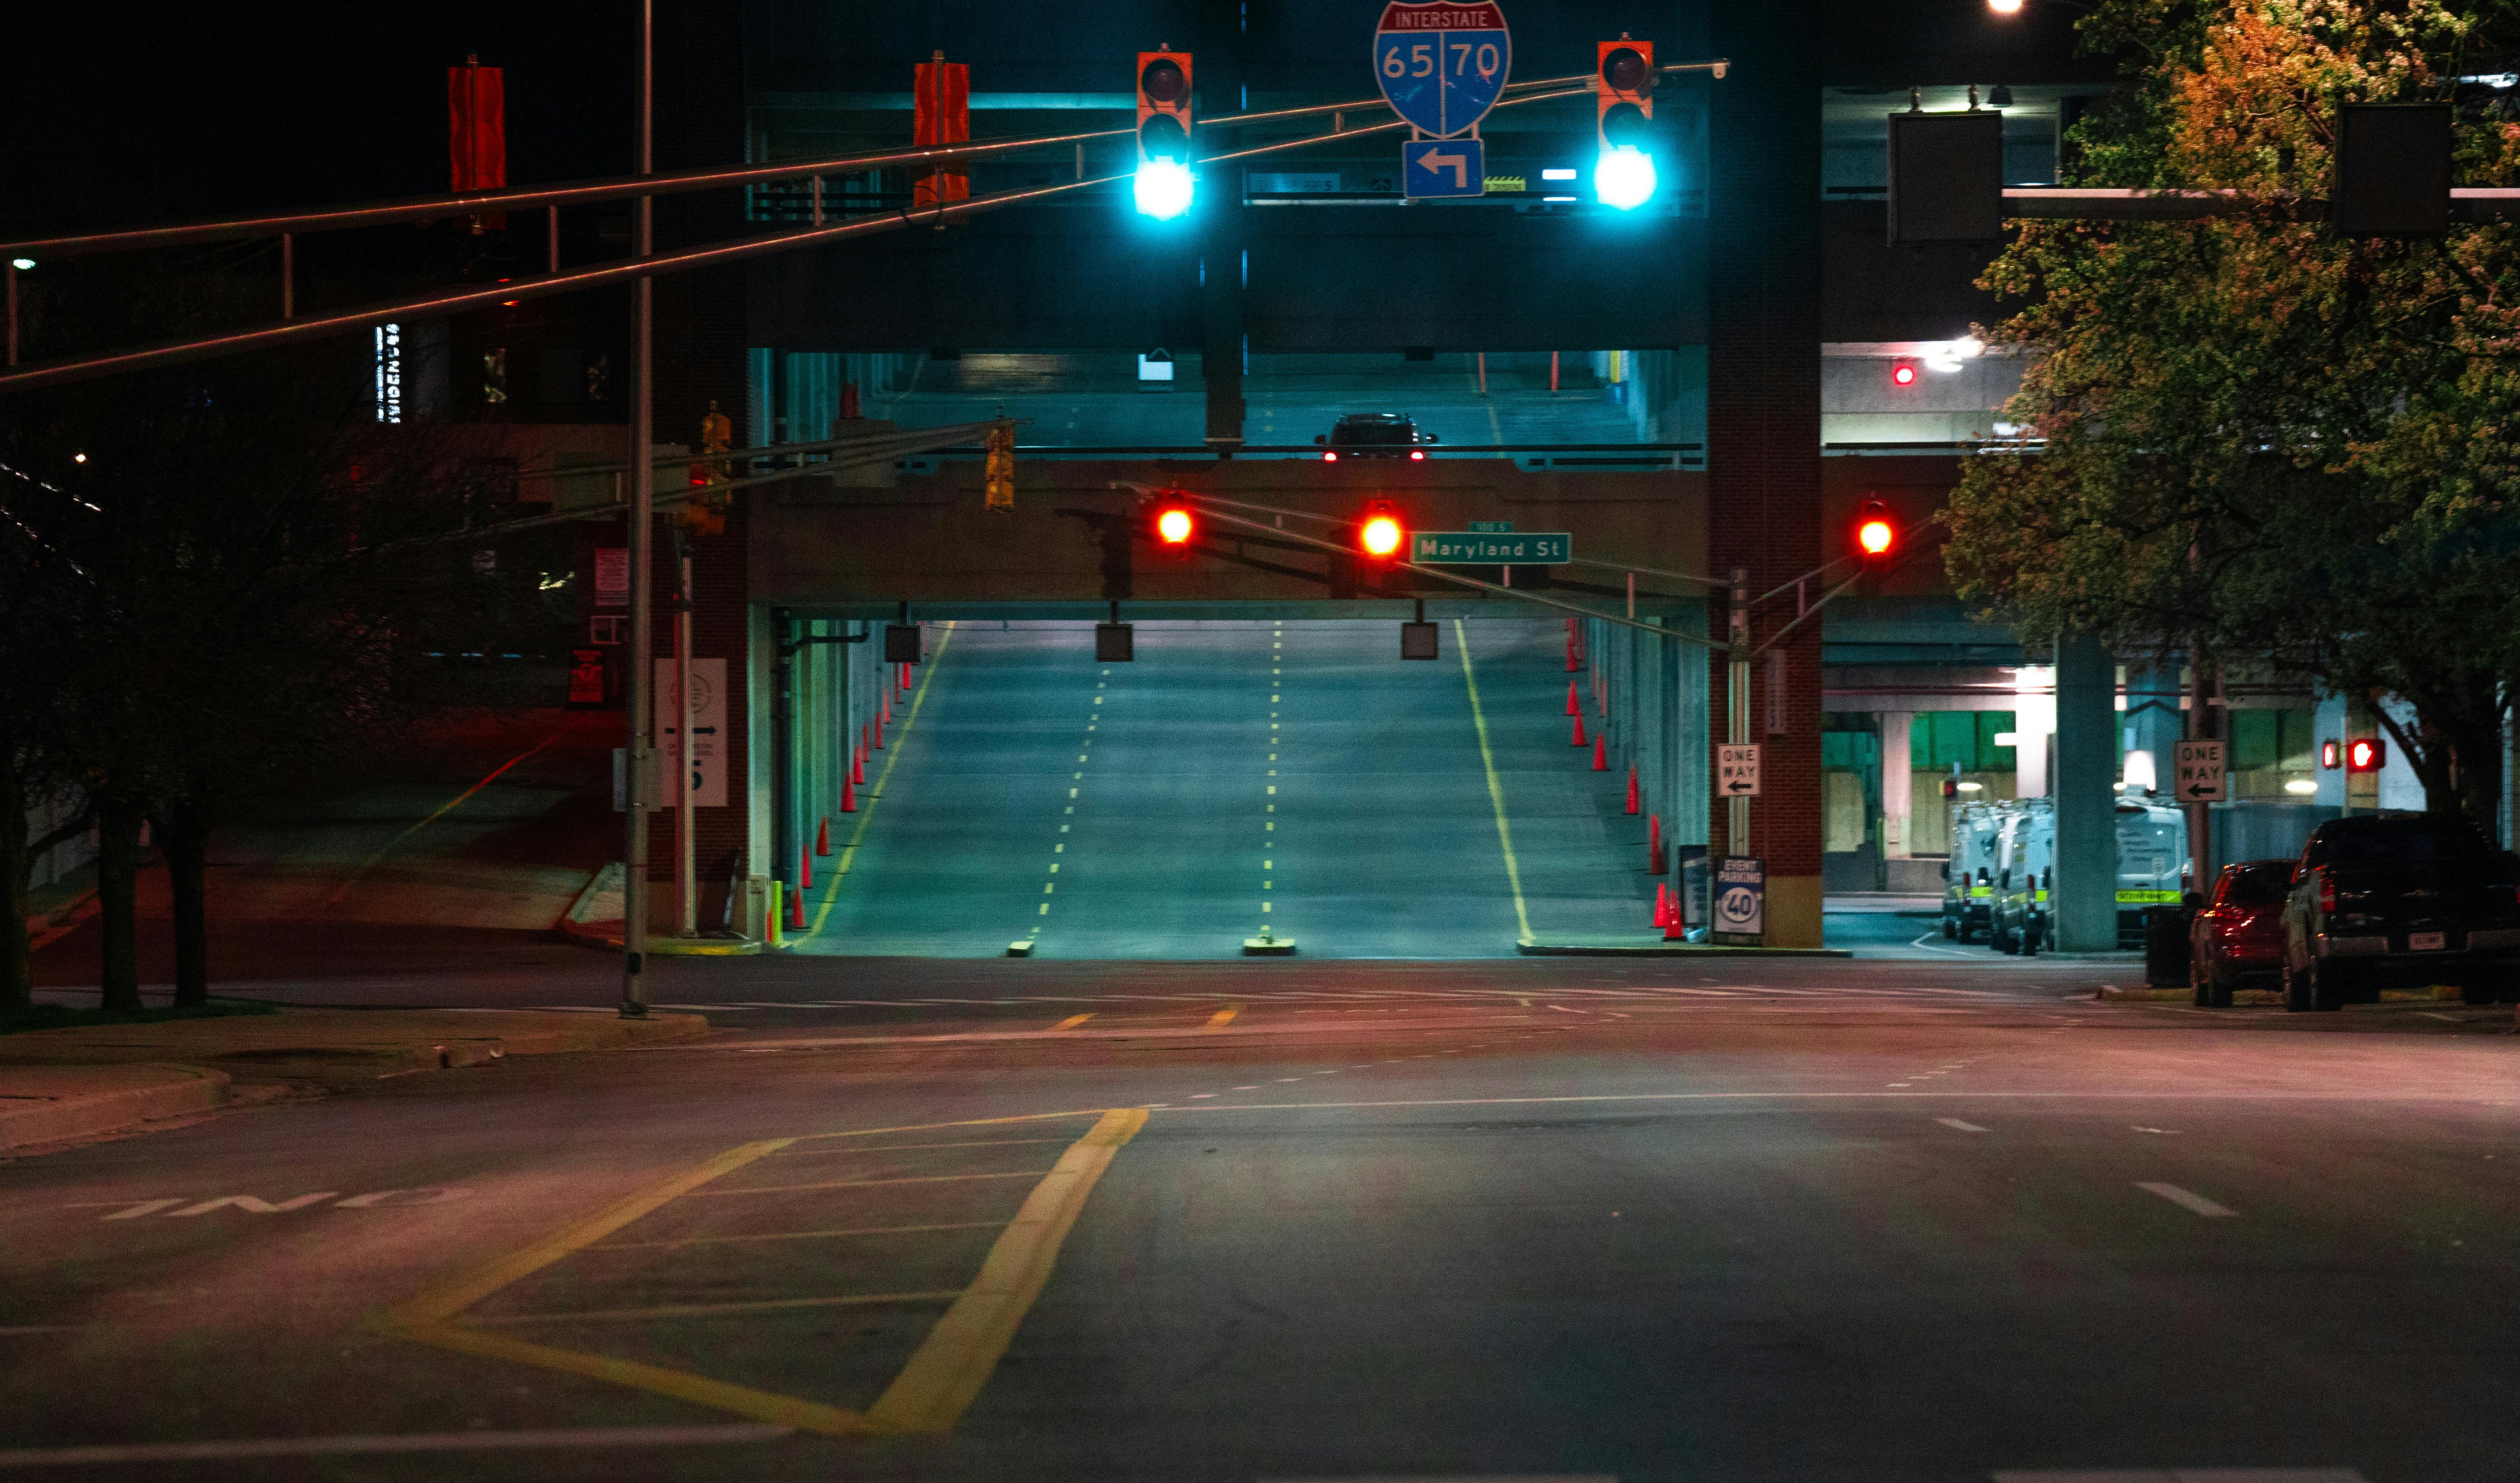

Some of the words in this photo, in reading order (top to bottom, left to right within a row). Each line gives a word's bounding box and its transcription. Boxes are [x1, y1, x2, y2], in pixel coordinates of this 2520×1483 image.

[1395, 11, 1489, 28] INTERSTATE
[1383, 44, 1434, 78] 65
[1450, 43, 1500, 76] 70
[1420, 539, 1525, 560] Maryland
[1536, 541, 1560, 557] St
[1723, 749, 1756, 762] ONE
[2182, 746, 2219, 761] ONE
[1722, 766, 1756, 779] WAY
[2181, 766, 2220, 780] WAY
[1723, 859, 1756, 871] EVENT
[1718, 871, 1762, 883] PARKING
